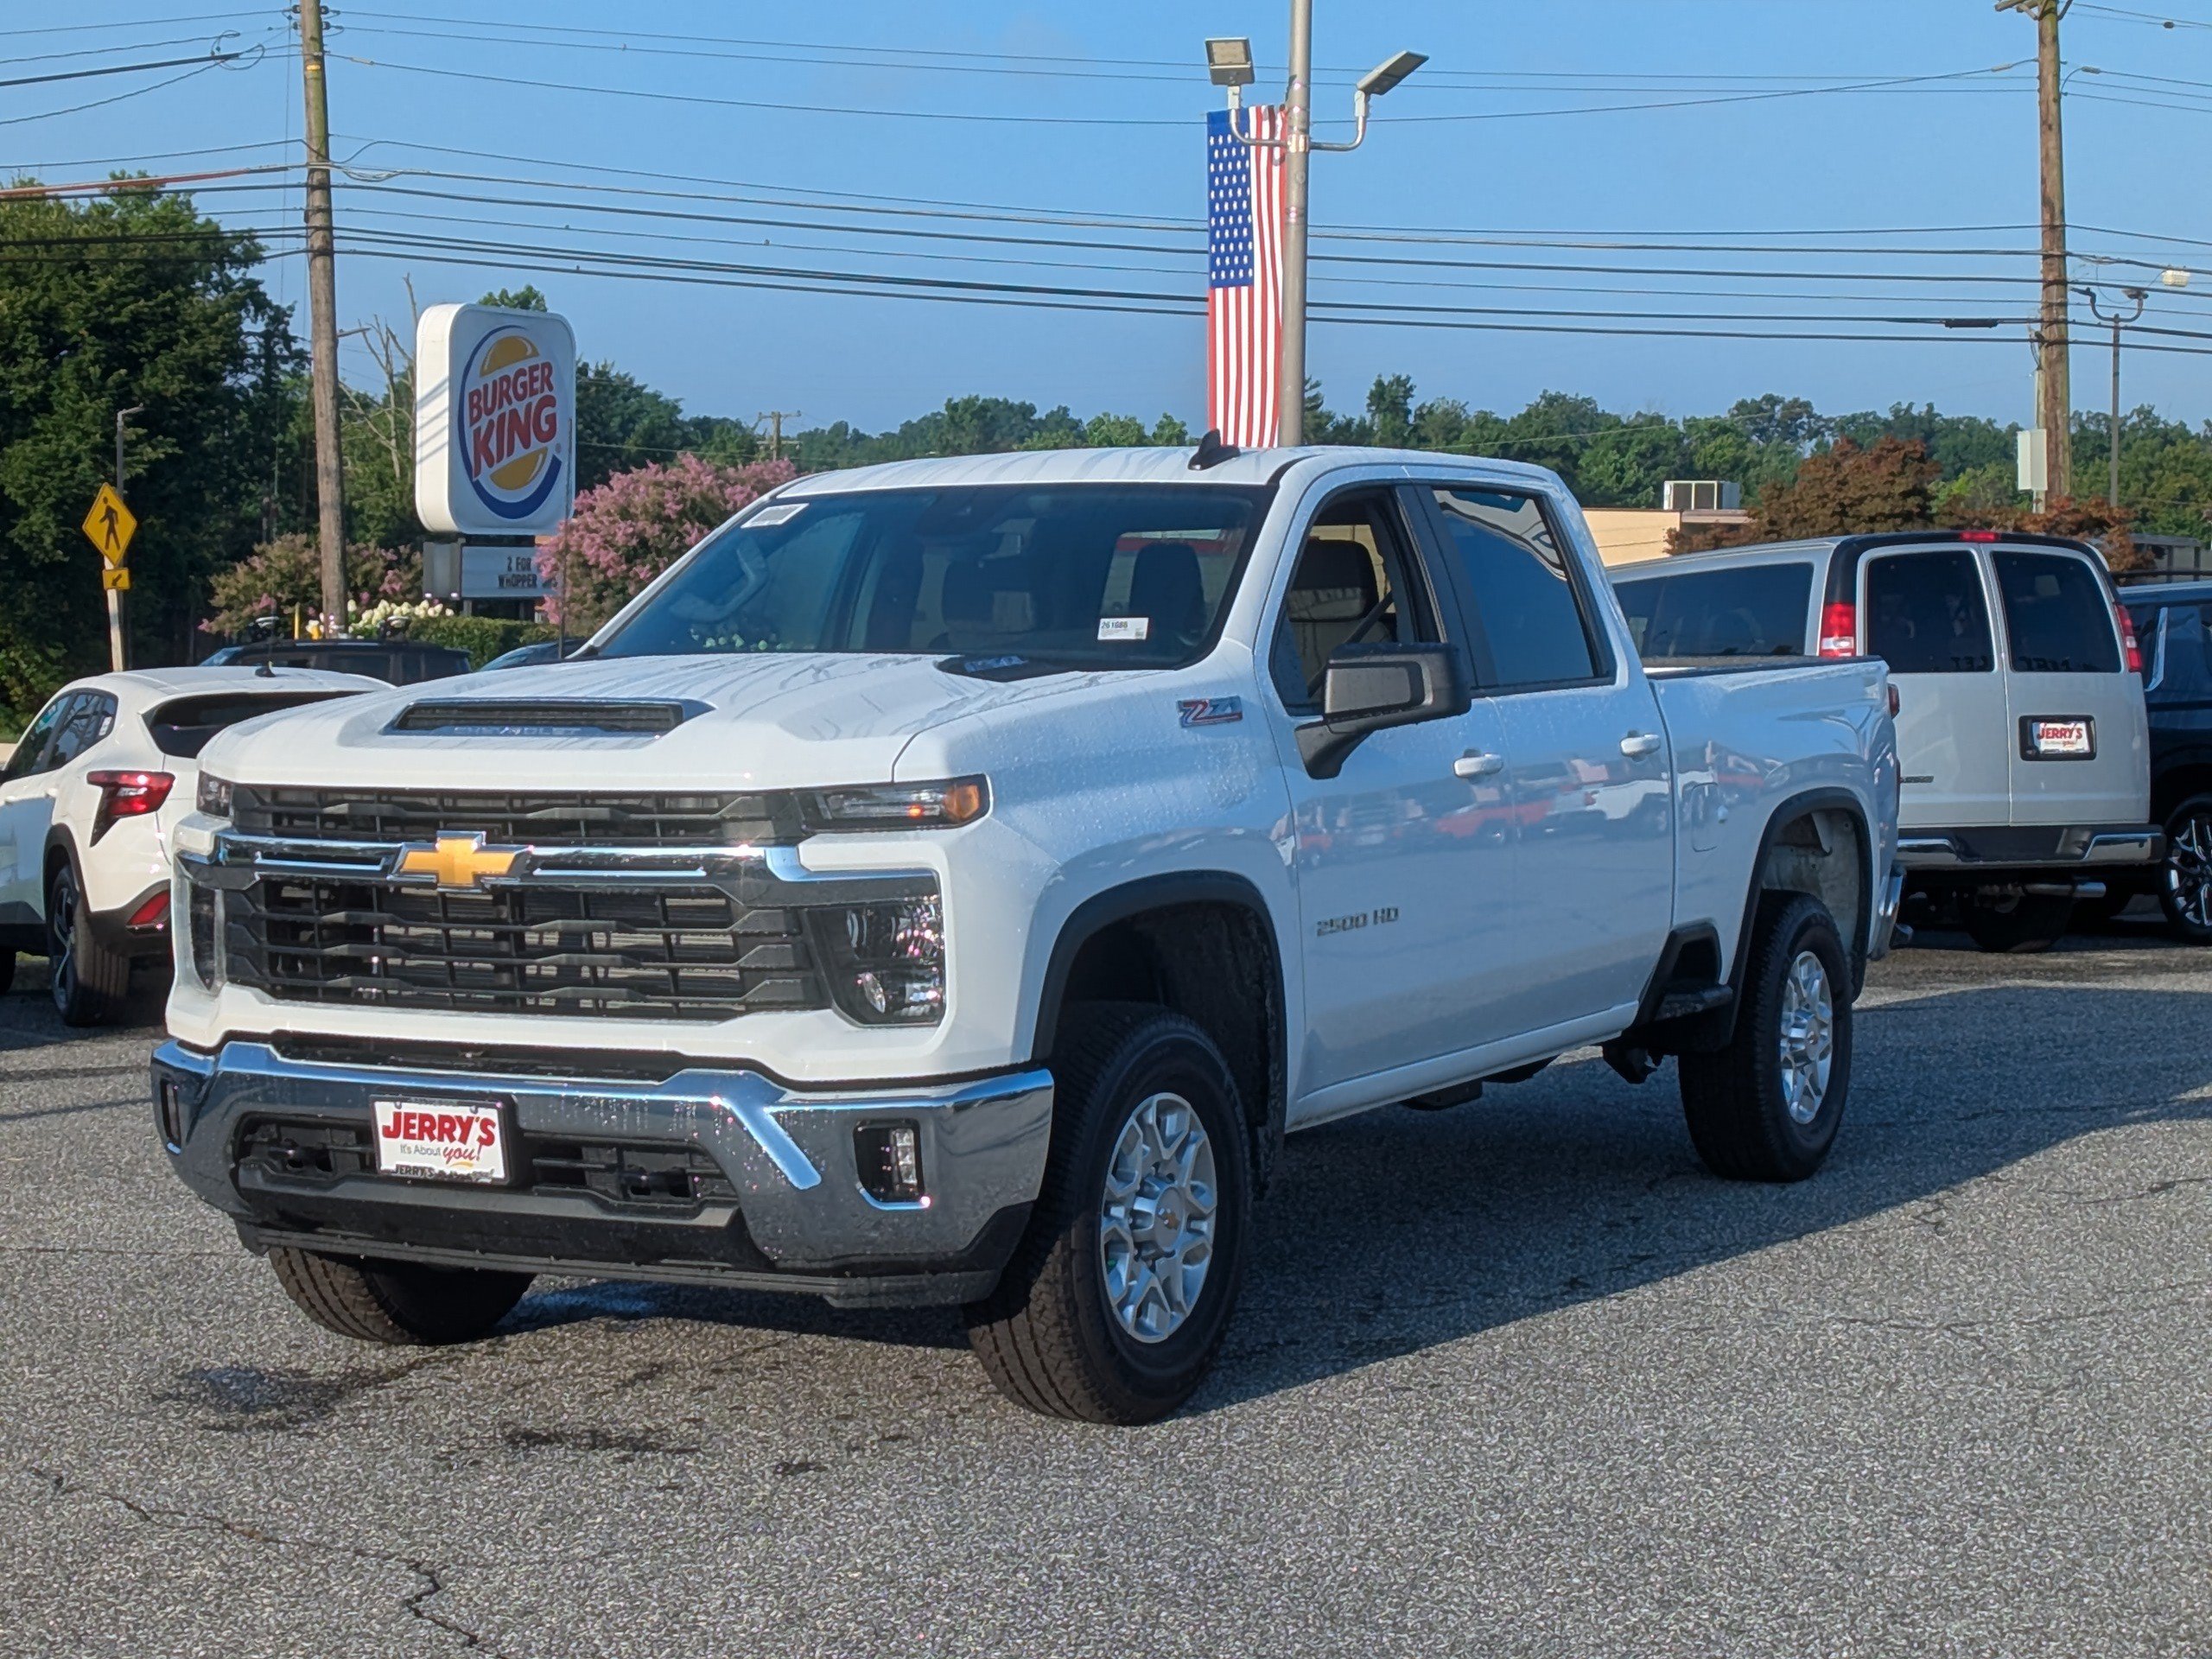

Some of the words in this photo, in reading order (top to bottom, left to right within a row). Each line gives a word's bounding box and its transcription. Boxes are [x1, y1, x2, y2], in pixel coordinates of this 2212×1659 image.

[468, 361, 554, 427] BURGER
[473, 394, 556, 481] KING
[507, 556, 513, 572] 2
[516, 556, 532, 572] FOR
[498, 574, 537, 588] WHOPPER
[2037, 727, 2083, 741] JERRY'S
[1317, 912, 1368, 937] 2500
[1373, 907, 1399, 925] HD
[382, 1111, 496, 1147] JERRY'S
[414, 1144, 441, 1156] About
